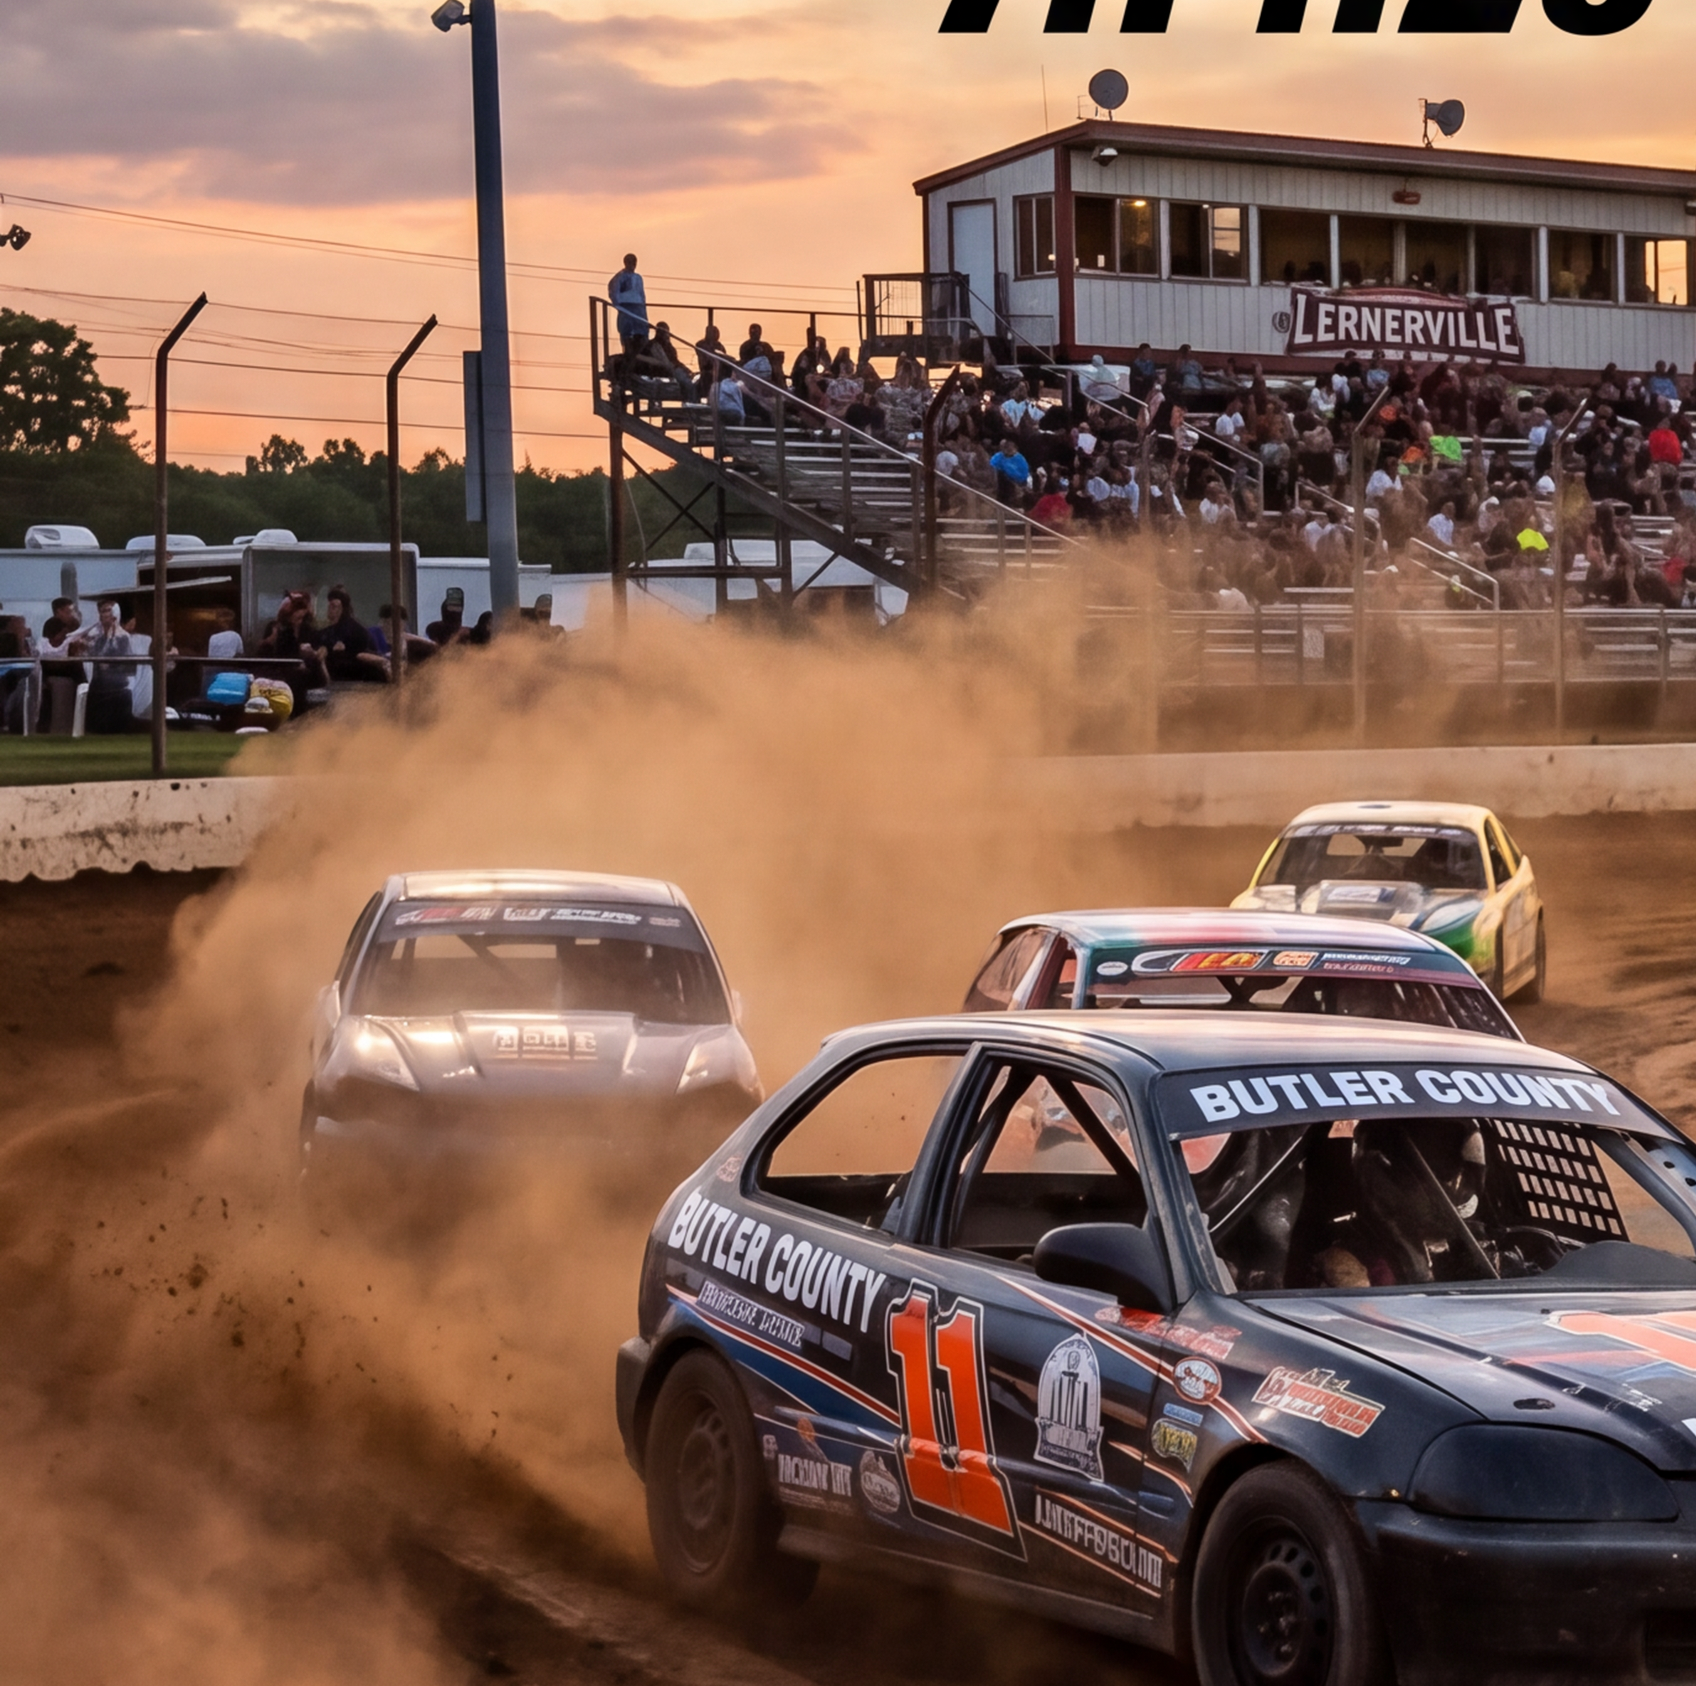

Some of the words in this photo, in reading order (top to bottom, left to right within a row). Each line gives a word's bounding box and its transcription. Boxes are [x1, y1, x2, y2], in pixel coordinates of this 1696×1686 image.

[1293, 293, 1520, 356] LERNERVILLE
[1189, 1070, 1415, 1123] BUTLER
[1414, 1069, 1621, 1116] COUNTY
[667, 1185, 772, 1285] BUTLER
[764, 1233, 888, 1334] COUNTY
[887, 1288, 1015, 1539] 11
